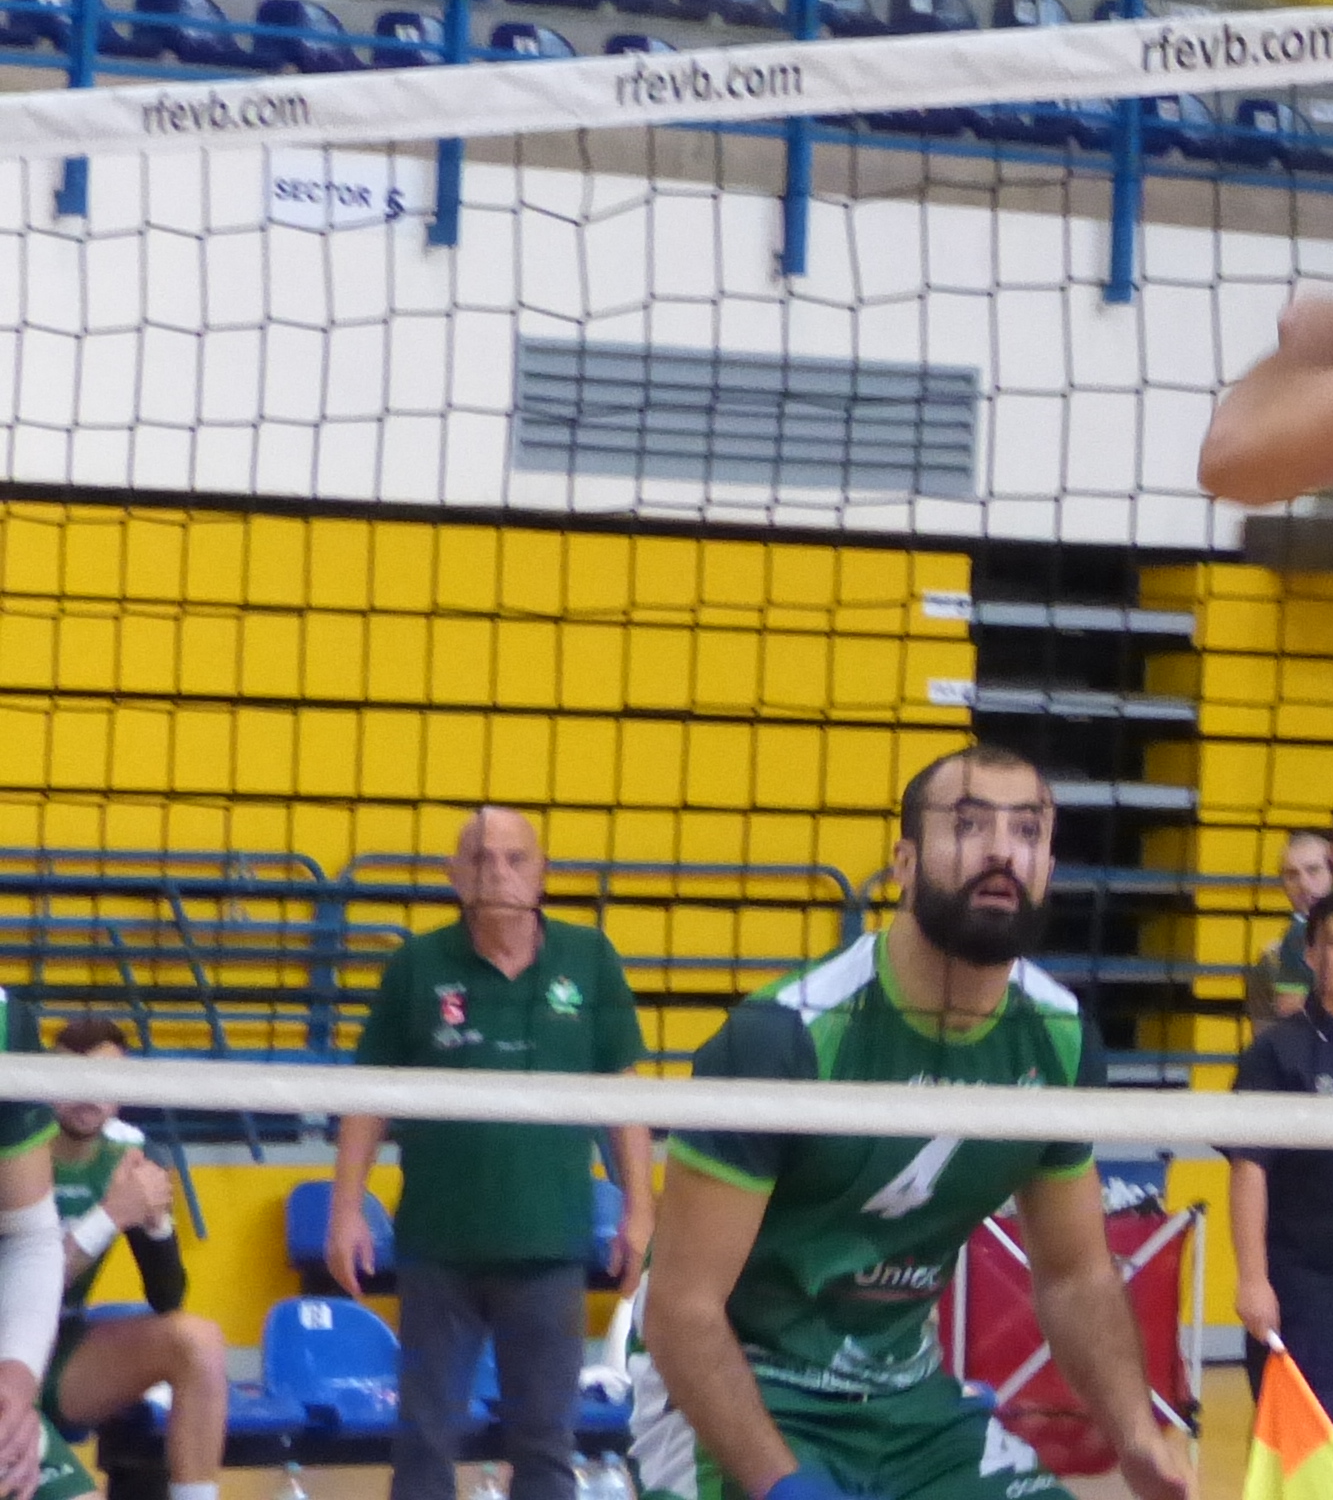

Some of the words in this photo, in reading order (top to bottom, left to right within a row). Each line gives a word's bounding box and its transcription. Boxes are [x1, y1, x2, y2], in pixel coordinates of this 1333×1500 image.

[615, 55, 805, 106] rfevb.com
[142, 89, 312, 135] rfevb.com
[274, 178, 372, 209] SECTOR
